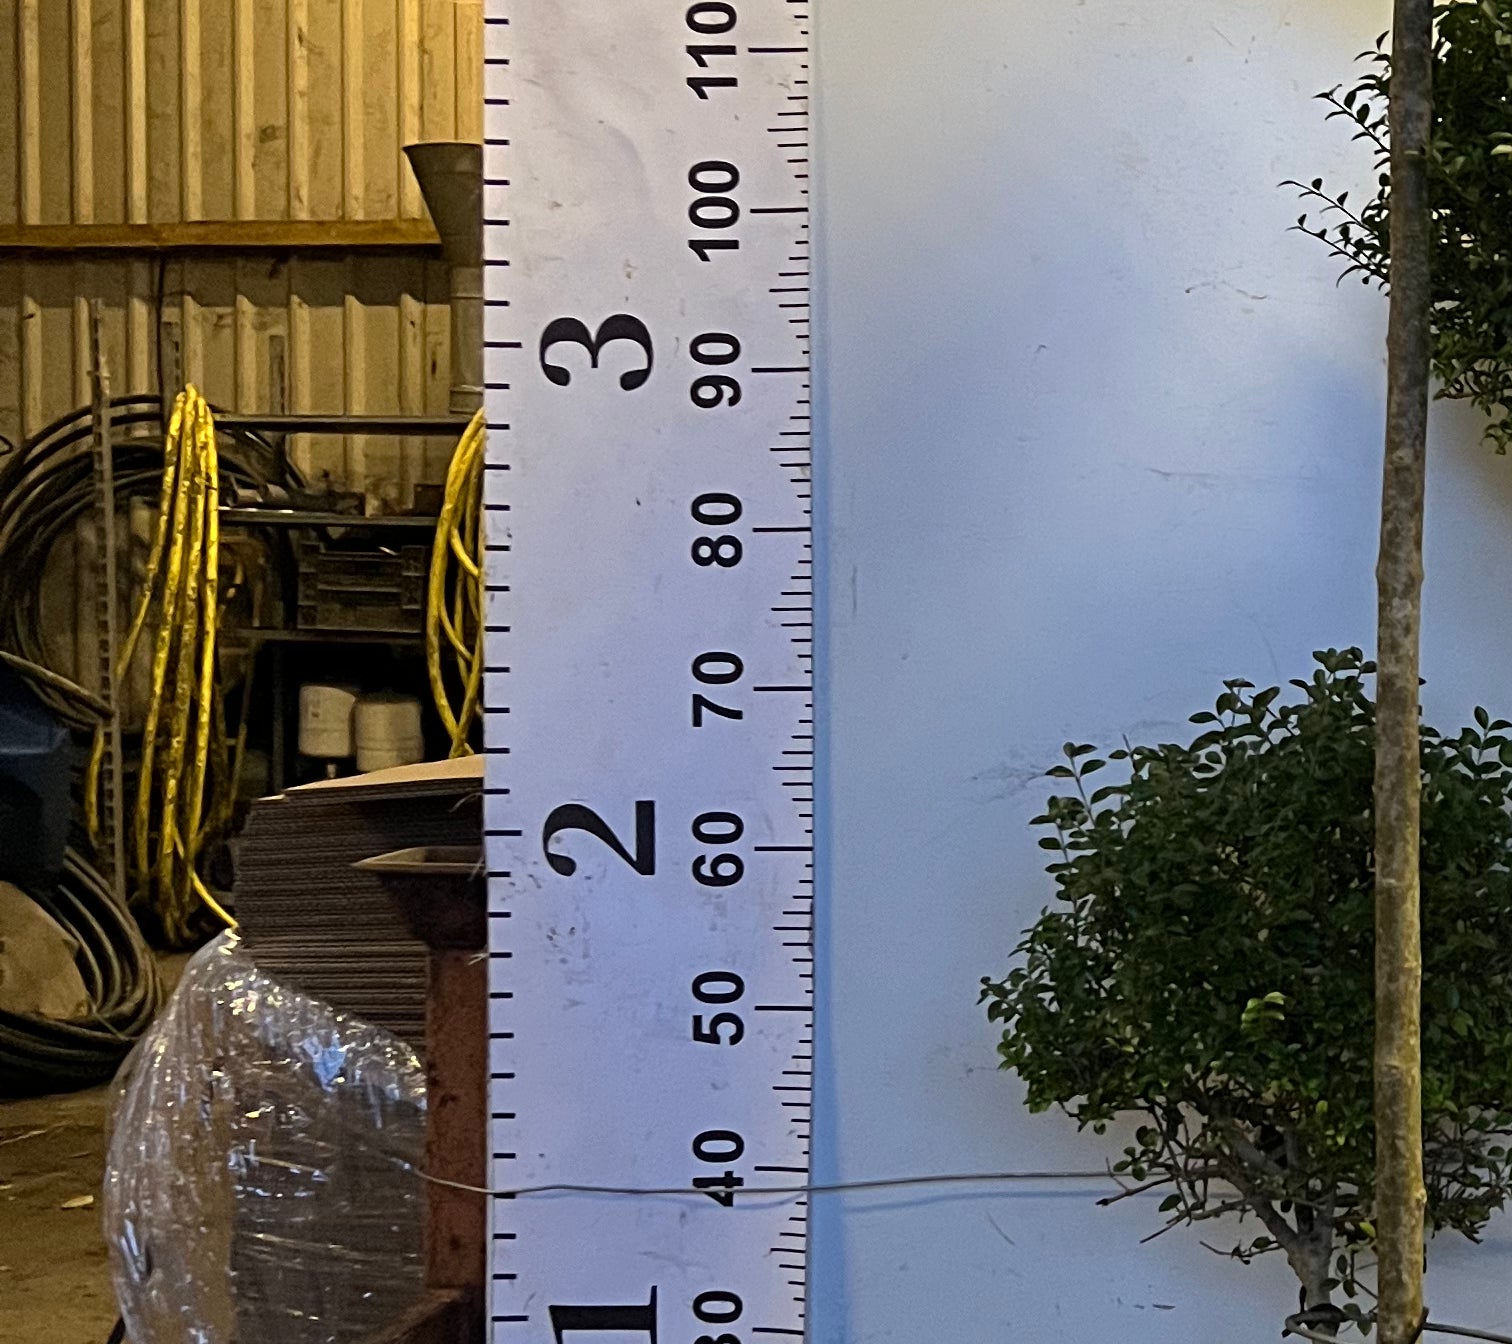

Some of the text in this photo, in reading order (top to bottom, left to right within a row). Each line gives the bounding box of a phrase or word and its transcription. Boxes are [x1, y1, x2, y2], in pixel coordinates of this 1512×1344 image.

[686, 2, 737, 99] 110
[688, 161, 740, 262] 100
[540, 314, 653, 391] 3
[690, 333, 741, 408] 90
[691, 493, 742, 567] 80
[692, 652, 743, 727] 70
[543, 800, 655, 876] 2
[692, 812, 744, 887] 60
[692, 972, 744, 1045] 50
[693, 1130, 744, 1207] 40
